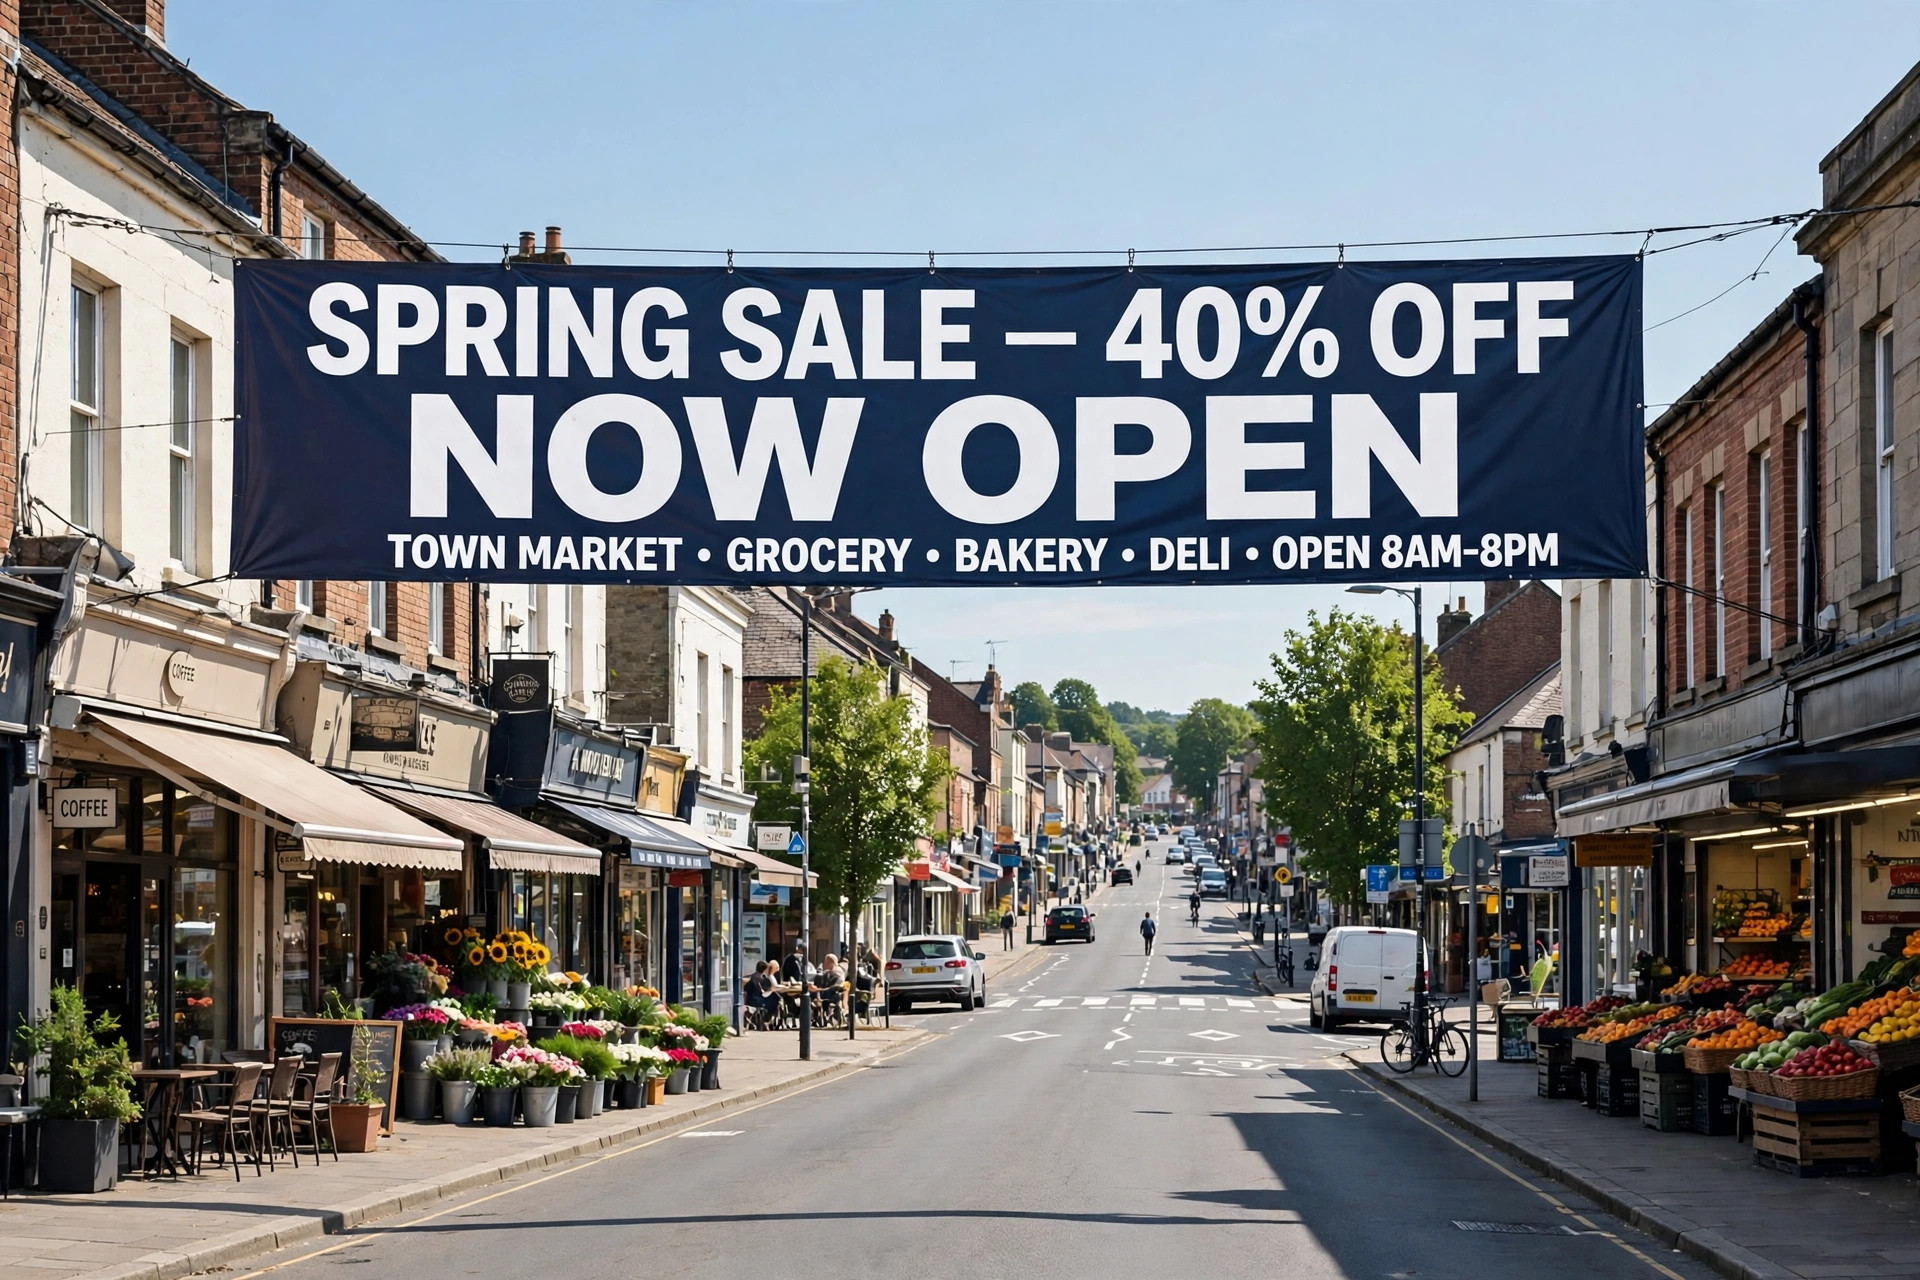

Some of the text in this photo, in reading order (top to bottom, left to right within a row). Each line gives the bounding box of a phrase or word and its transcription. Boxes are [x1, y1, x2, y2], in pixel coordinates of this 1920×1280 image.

[307, 282, 689, 380] SPRING
[720, 288, 976, 381] SALE
[1106, 285, 1340, 380] 40%
[1370, 280, 1574, 378] OFF
[409, 391, 1460, 525] NOW OPEN
[387, 532, 1559, 573] TOWN MARKET GROCERY BAKERY DELI OPEN 8AM-8PM
[172, 663, 196, 682] COFFEE
[60, 799, 108, 817] COFFEE
